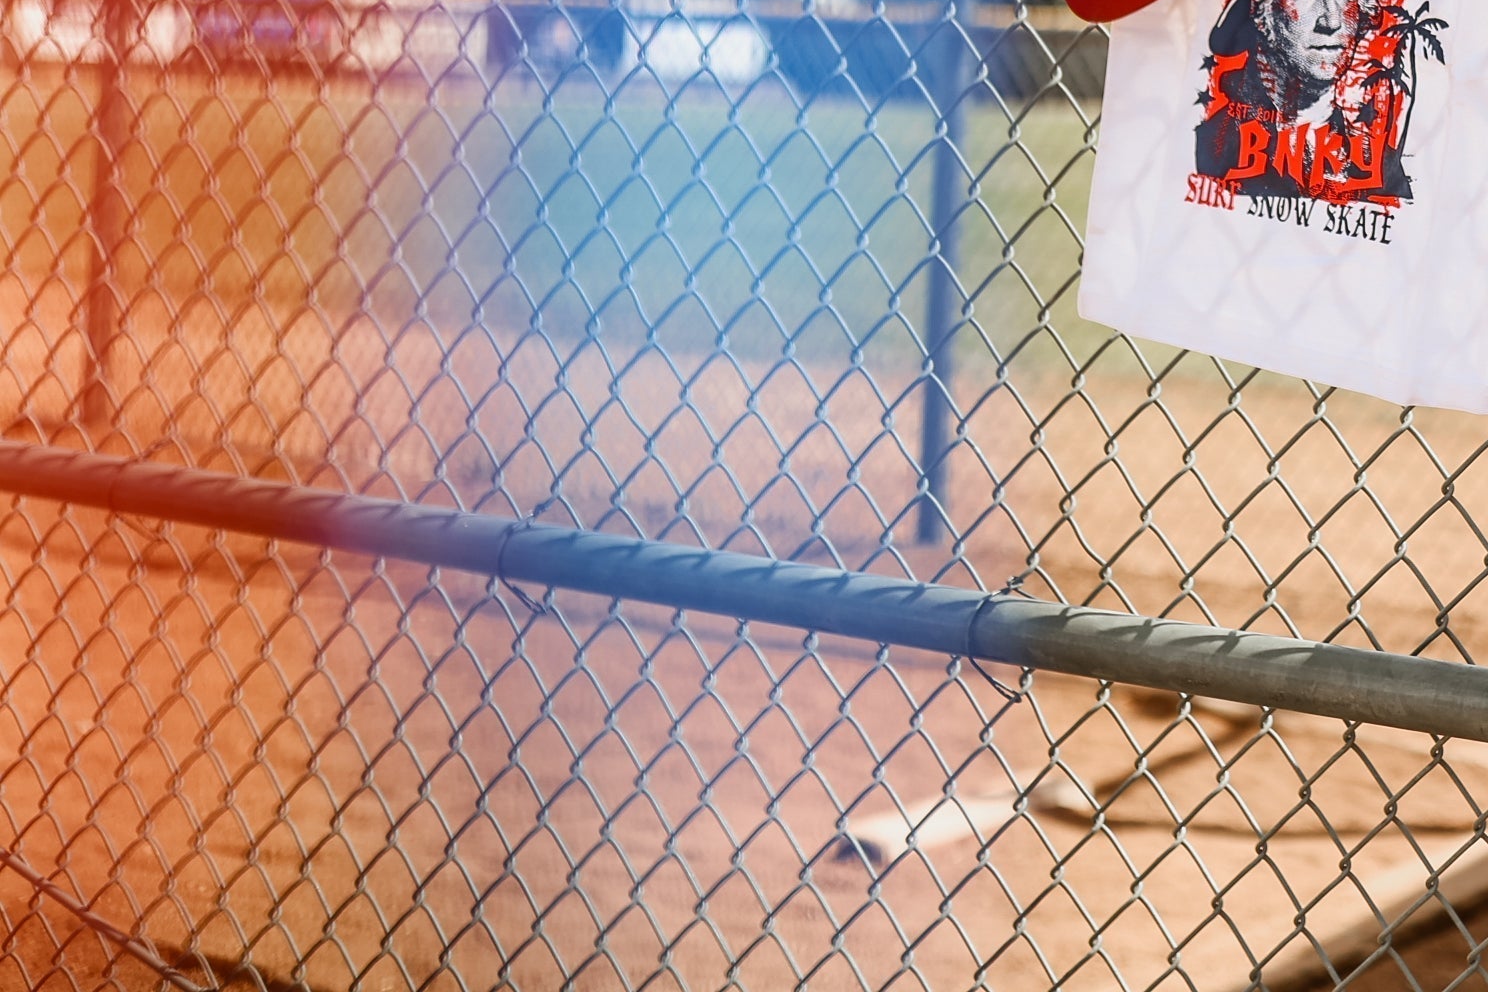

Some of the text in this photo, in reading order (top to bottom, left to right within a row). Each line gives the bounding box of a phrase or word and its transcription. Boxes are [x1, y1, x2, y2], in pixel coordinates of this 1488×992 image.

[1224, 119, 1388, 193] BNKY
[1247, 195, 1317, 228] SNOW
[1323, 204, 1395, 245] SKATE
